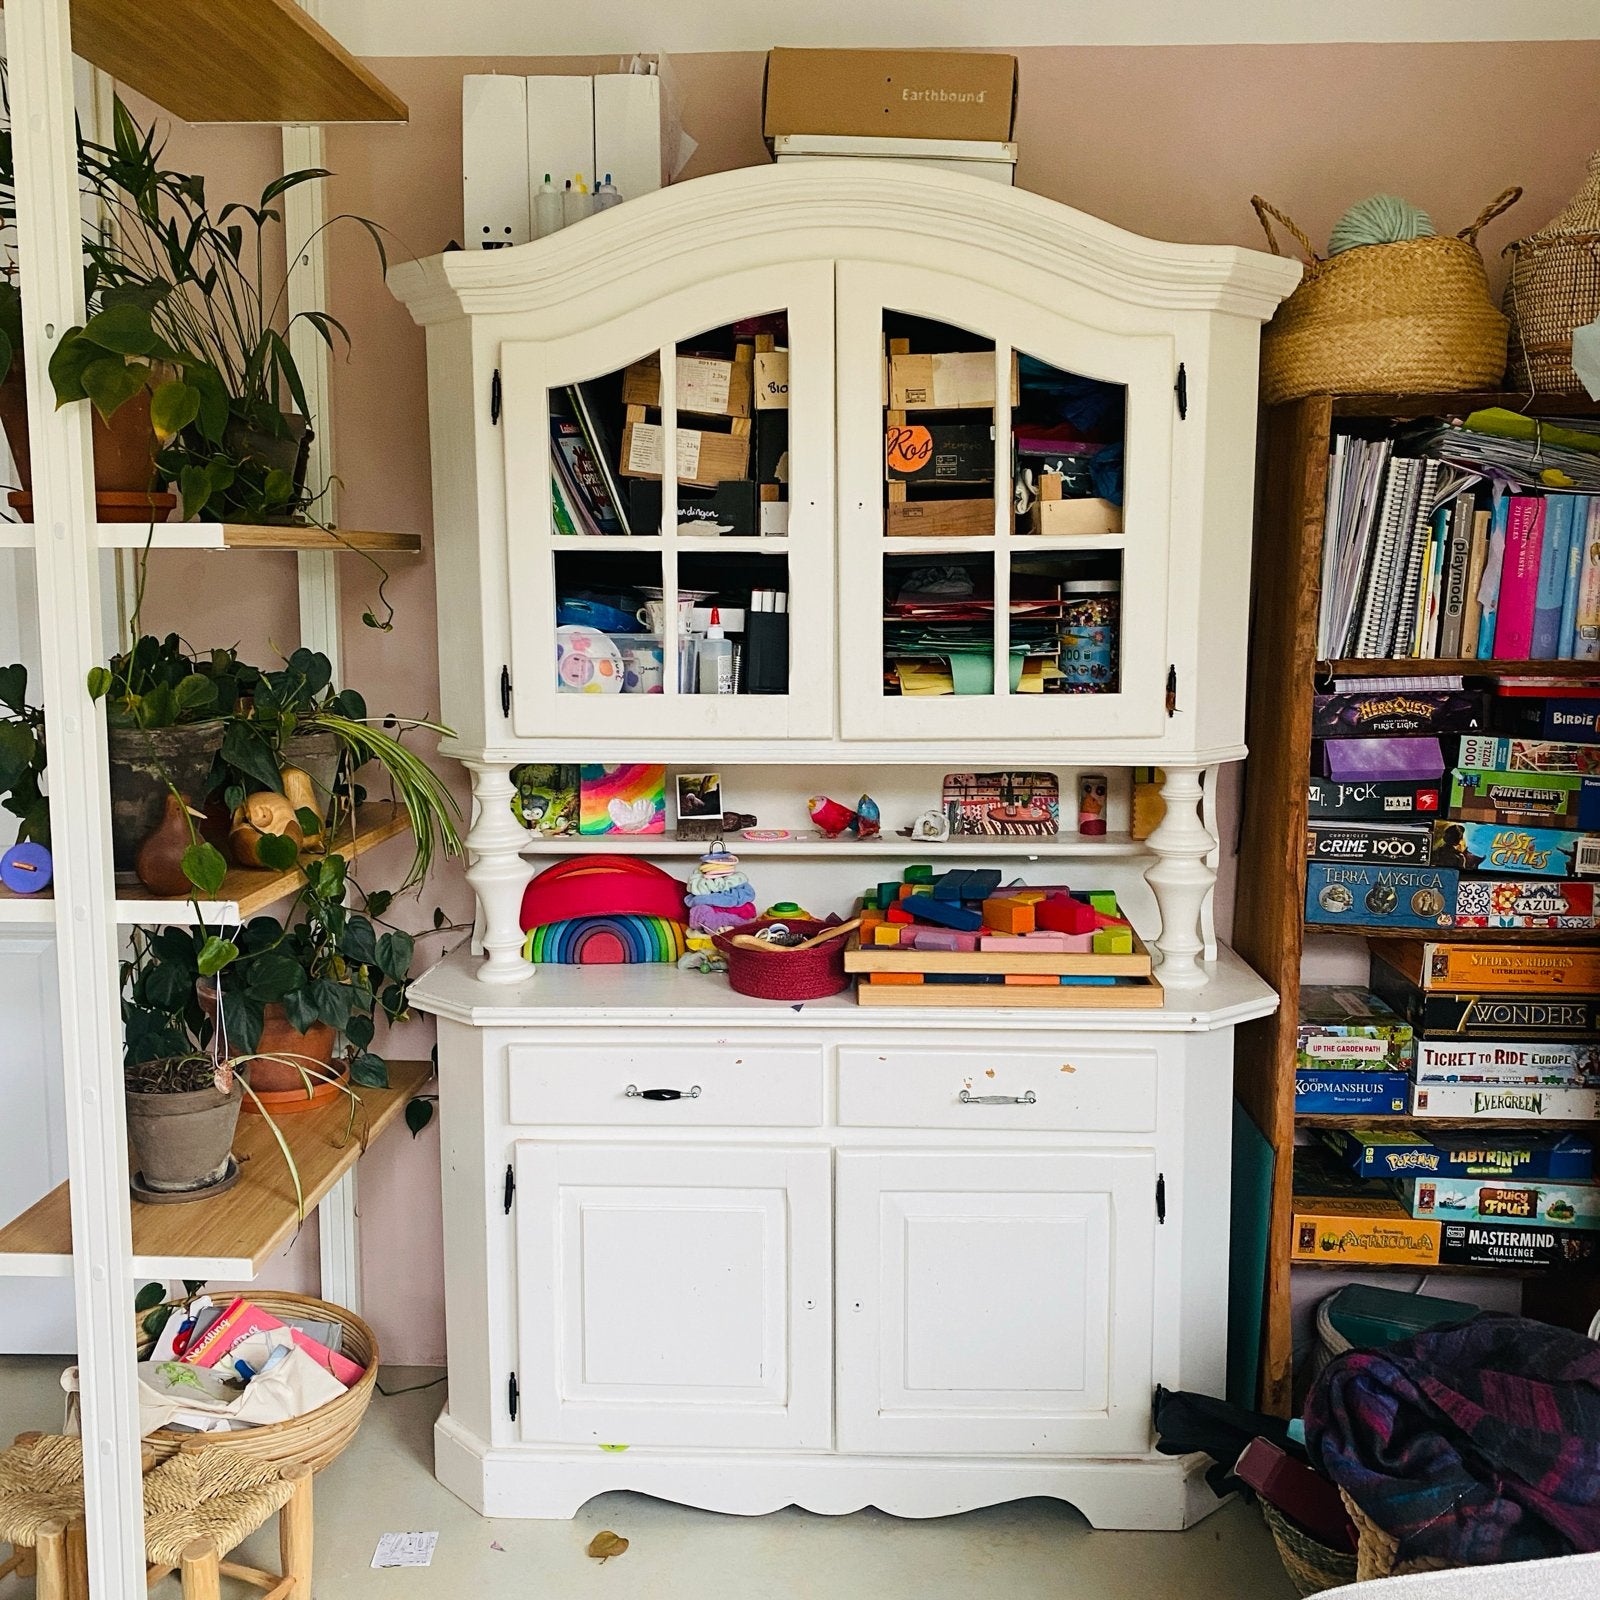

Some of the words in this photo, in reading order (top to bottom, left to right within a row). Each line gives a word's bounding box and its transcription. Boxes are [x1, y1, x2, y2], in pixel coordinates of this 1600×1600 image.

[902, 88, 987, 103] Earthbound
[1512, 519, 1520, 540] ALLES
[1517, 550, 1526, 578] WISTEN
[1449, 542, 1468, 613] playmode
[1359, 696, 1436, 720] HEROQUEST
[1553, 711, 1594, 726] BIRDIE
[1465, 739, 1478, 767] 1000
[1482, 740, 1493, 768] PUZZLE
[1491, 786, 1565, 801] MINECRAFT
[1319, 840, 1369, 853] CRIME
[1372, 840, 1416, 856] 1900
[1491, 831, 1536, 850] LOST
[1490, 849, 1552, 870] CITIES
[1322, 867, 1370, 885] TERRA
[1378, 870, 1443, 888] MYSTICA
[1522, 900, 1560, 911] AZUL
[1525, 956, 1574, 968] RIDDERS
[1455, 995, 1482, 1033] 7
[1473, 1004, 1587, 1025] WONDERS
[1336, 1045, 1364, 1053] GARDEN
[1424, 1049, 1477, 1067] TICKET
[1478, 1053, 1492, 1064] TO
[1494, 1049, 1529, 1066] RIDE
[1531, 1053, 1571, 1065] EUROPE
[1295, 1079, 1384, 1095] KOOPMANSHUIS
[1473, 1091, 1543, 1116] EVERGREEN
[1449, 1150, 1531, 1167] LABYRINTH
[1342, 1229, 1434, 1251] AGRICOLA
[1468, 1229, 1555, 1248] MASTERMIND
[1488, 1246, 1535, 1258] CHALLENGE
[185, 1318, 231, 1361] Needling
